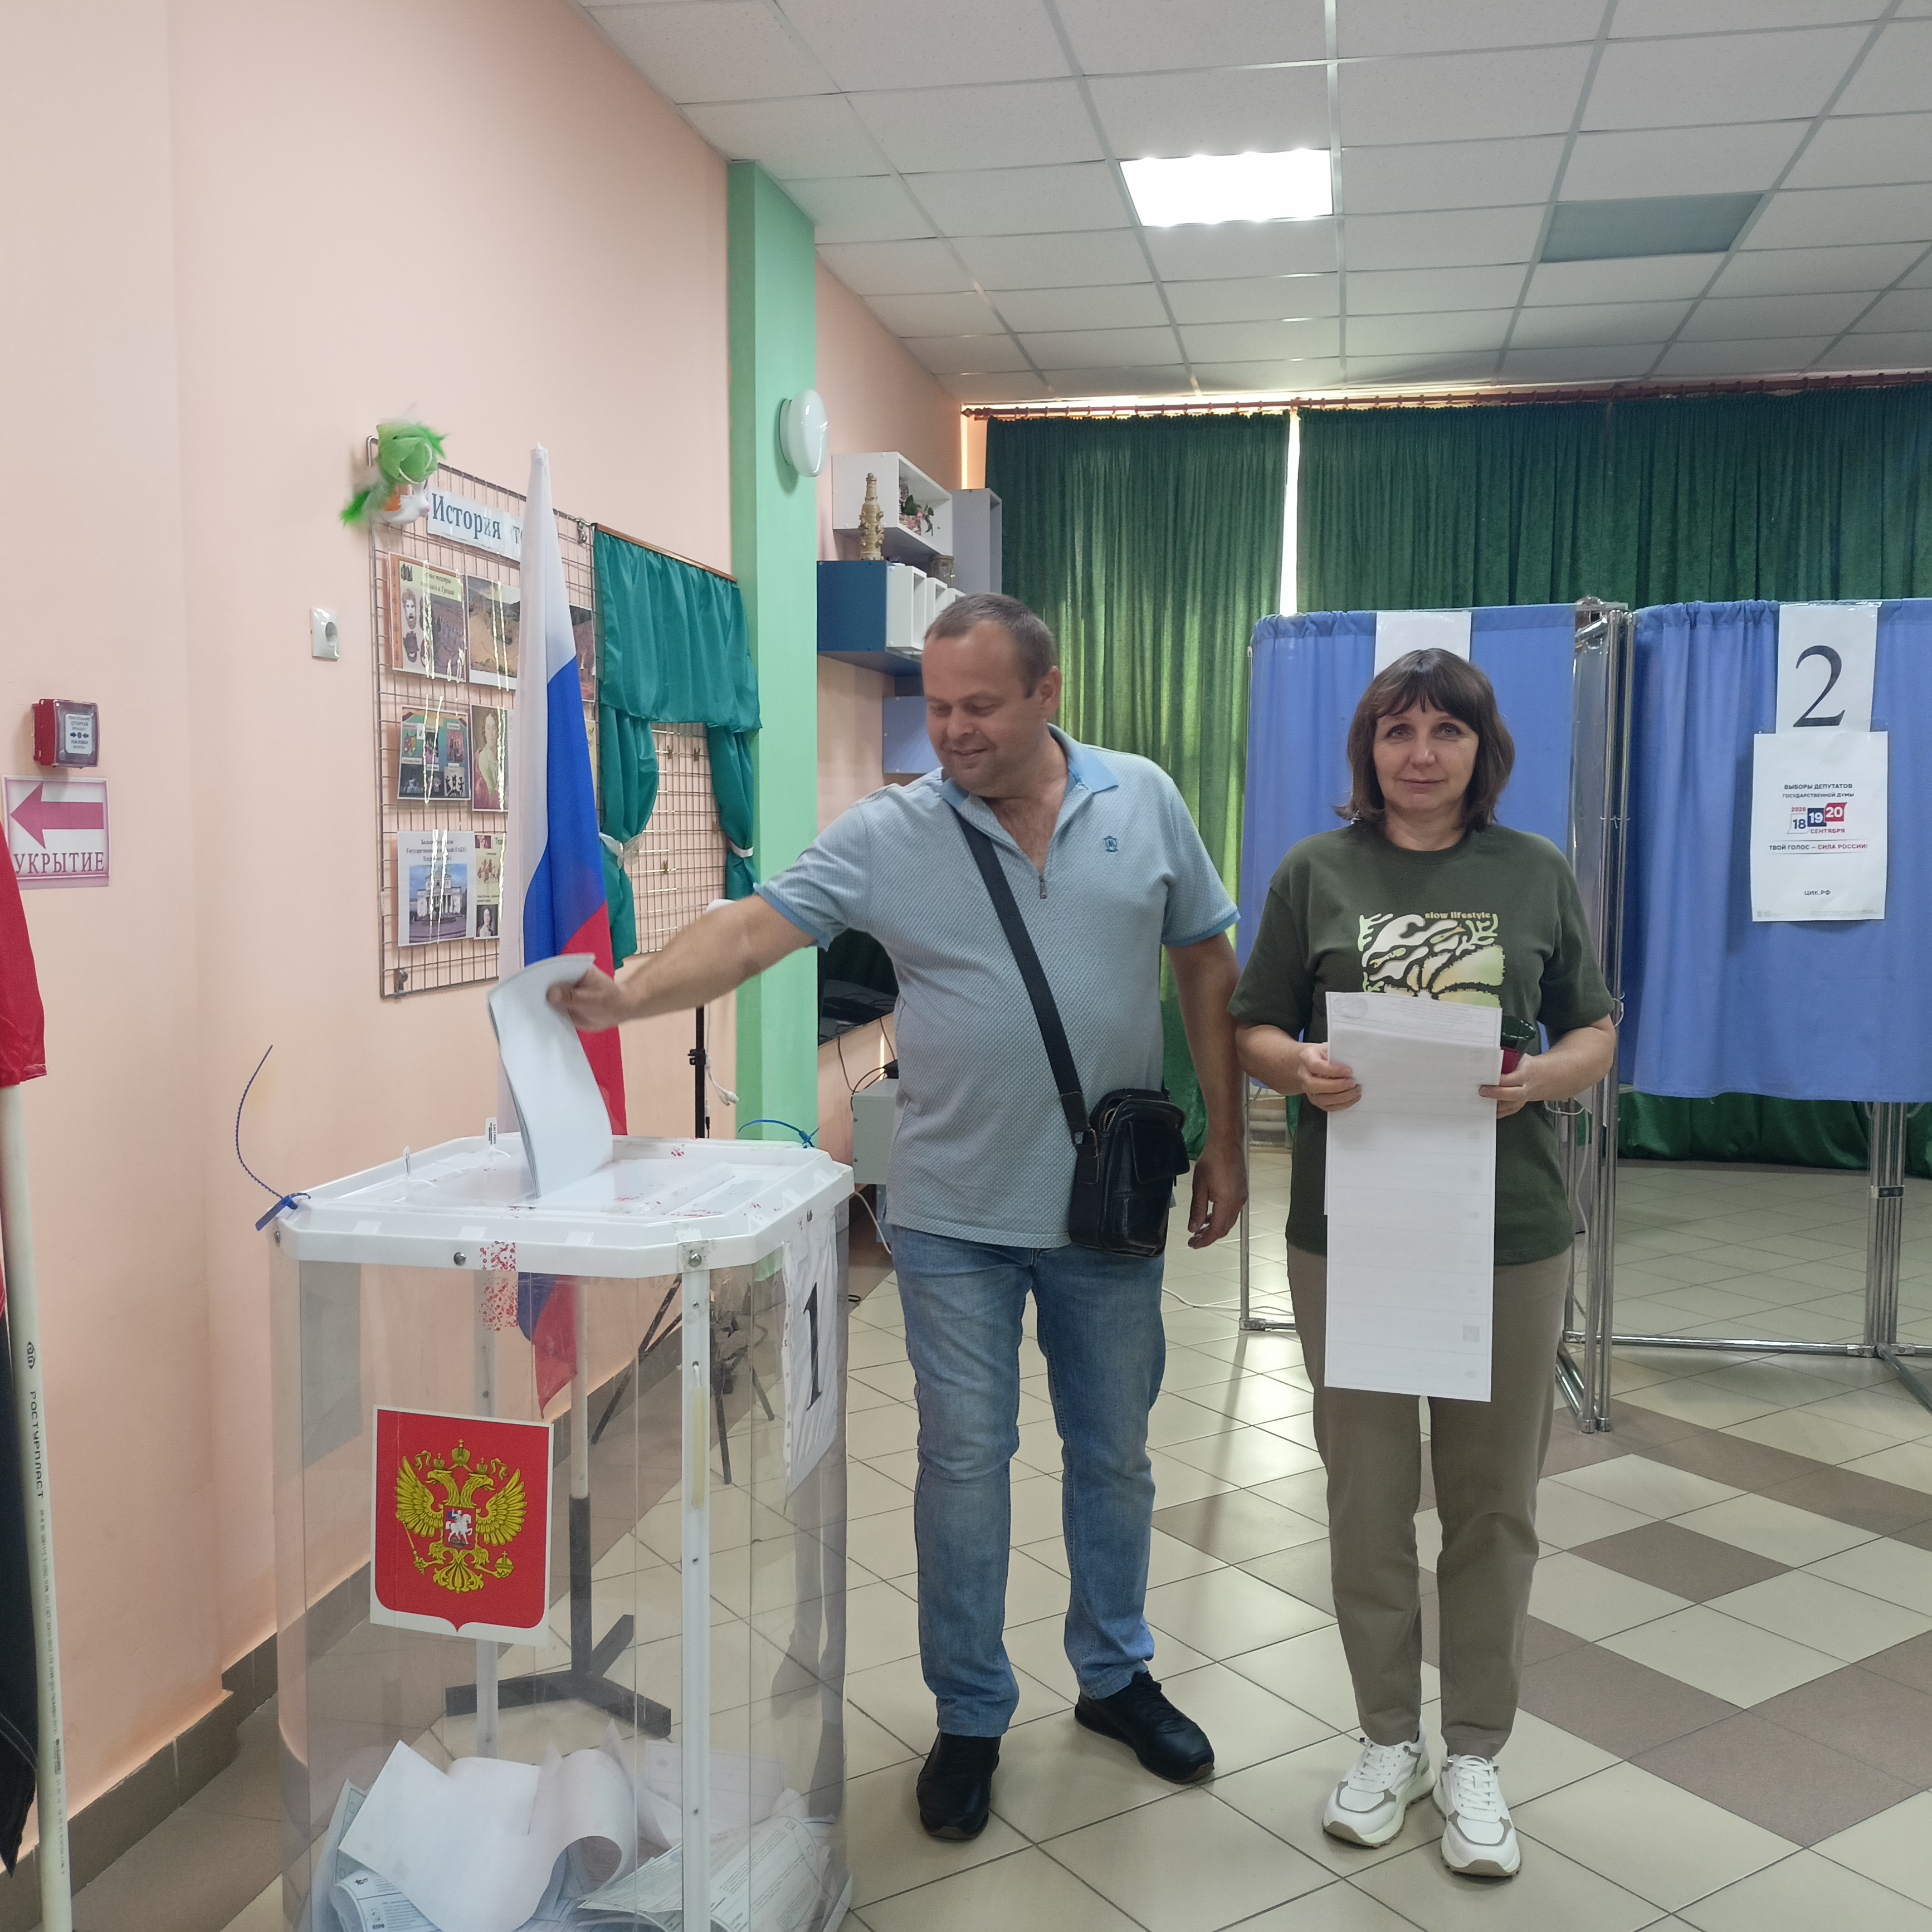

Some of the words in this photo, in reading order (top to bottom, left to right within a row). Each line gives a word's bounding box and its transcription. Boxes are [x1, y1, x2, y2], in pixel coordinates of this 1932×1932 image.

[432, 493, 501, 539] История
[1793, 645, 1845, 728] 2
[1793, 819, 1806, 829] 18
[1809, 812, 1823, 823] 19
[1826, 807, 1843, 818] 20
[13, 852, 104, 874] УКРЫТИЕ
[803, 1281, 823, 1411] 1
